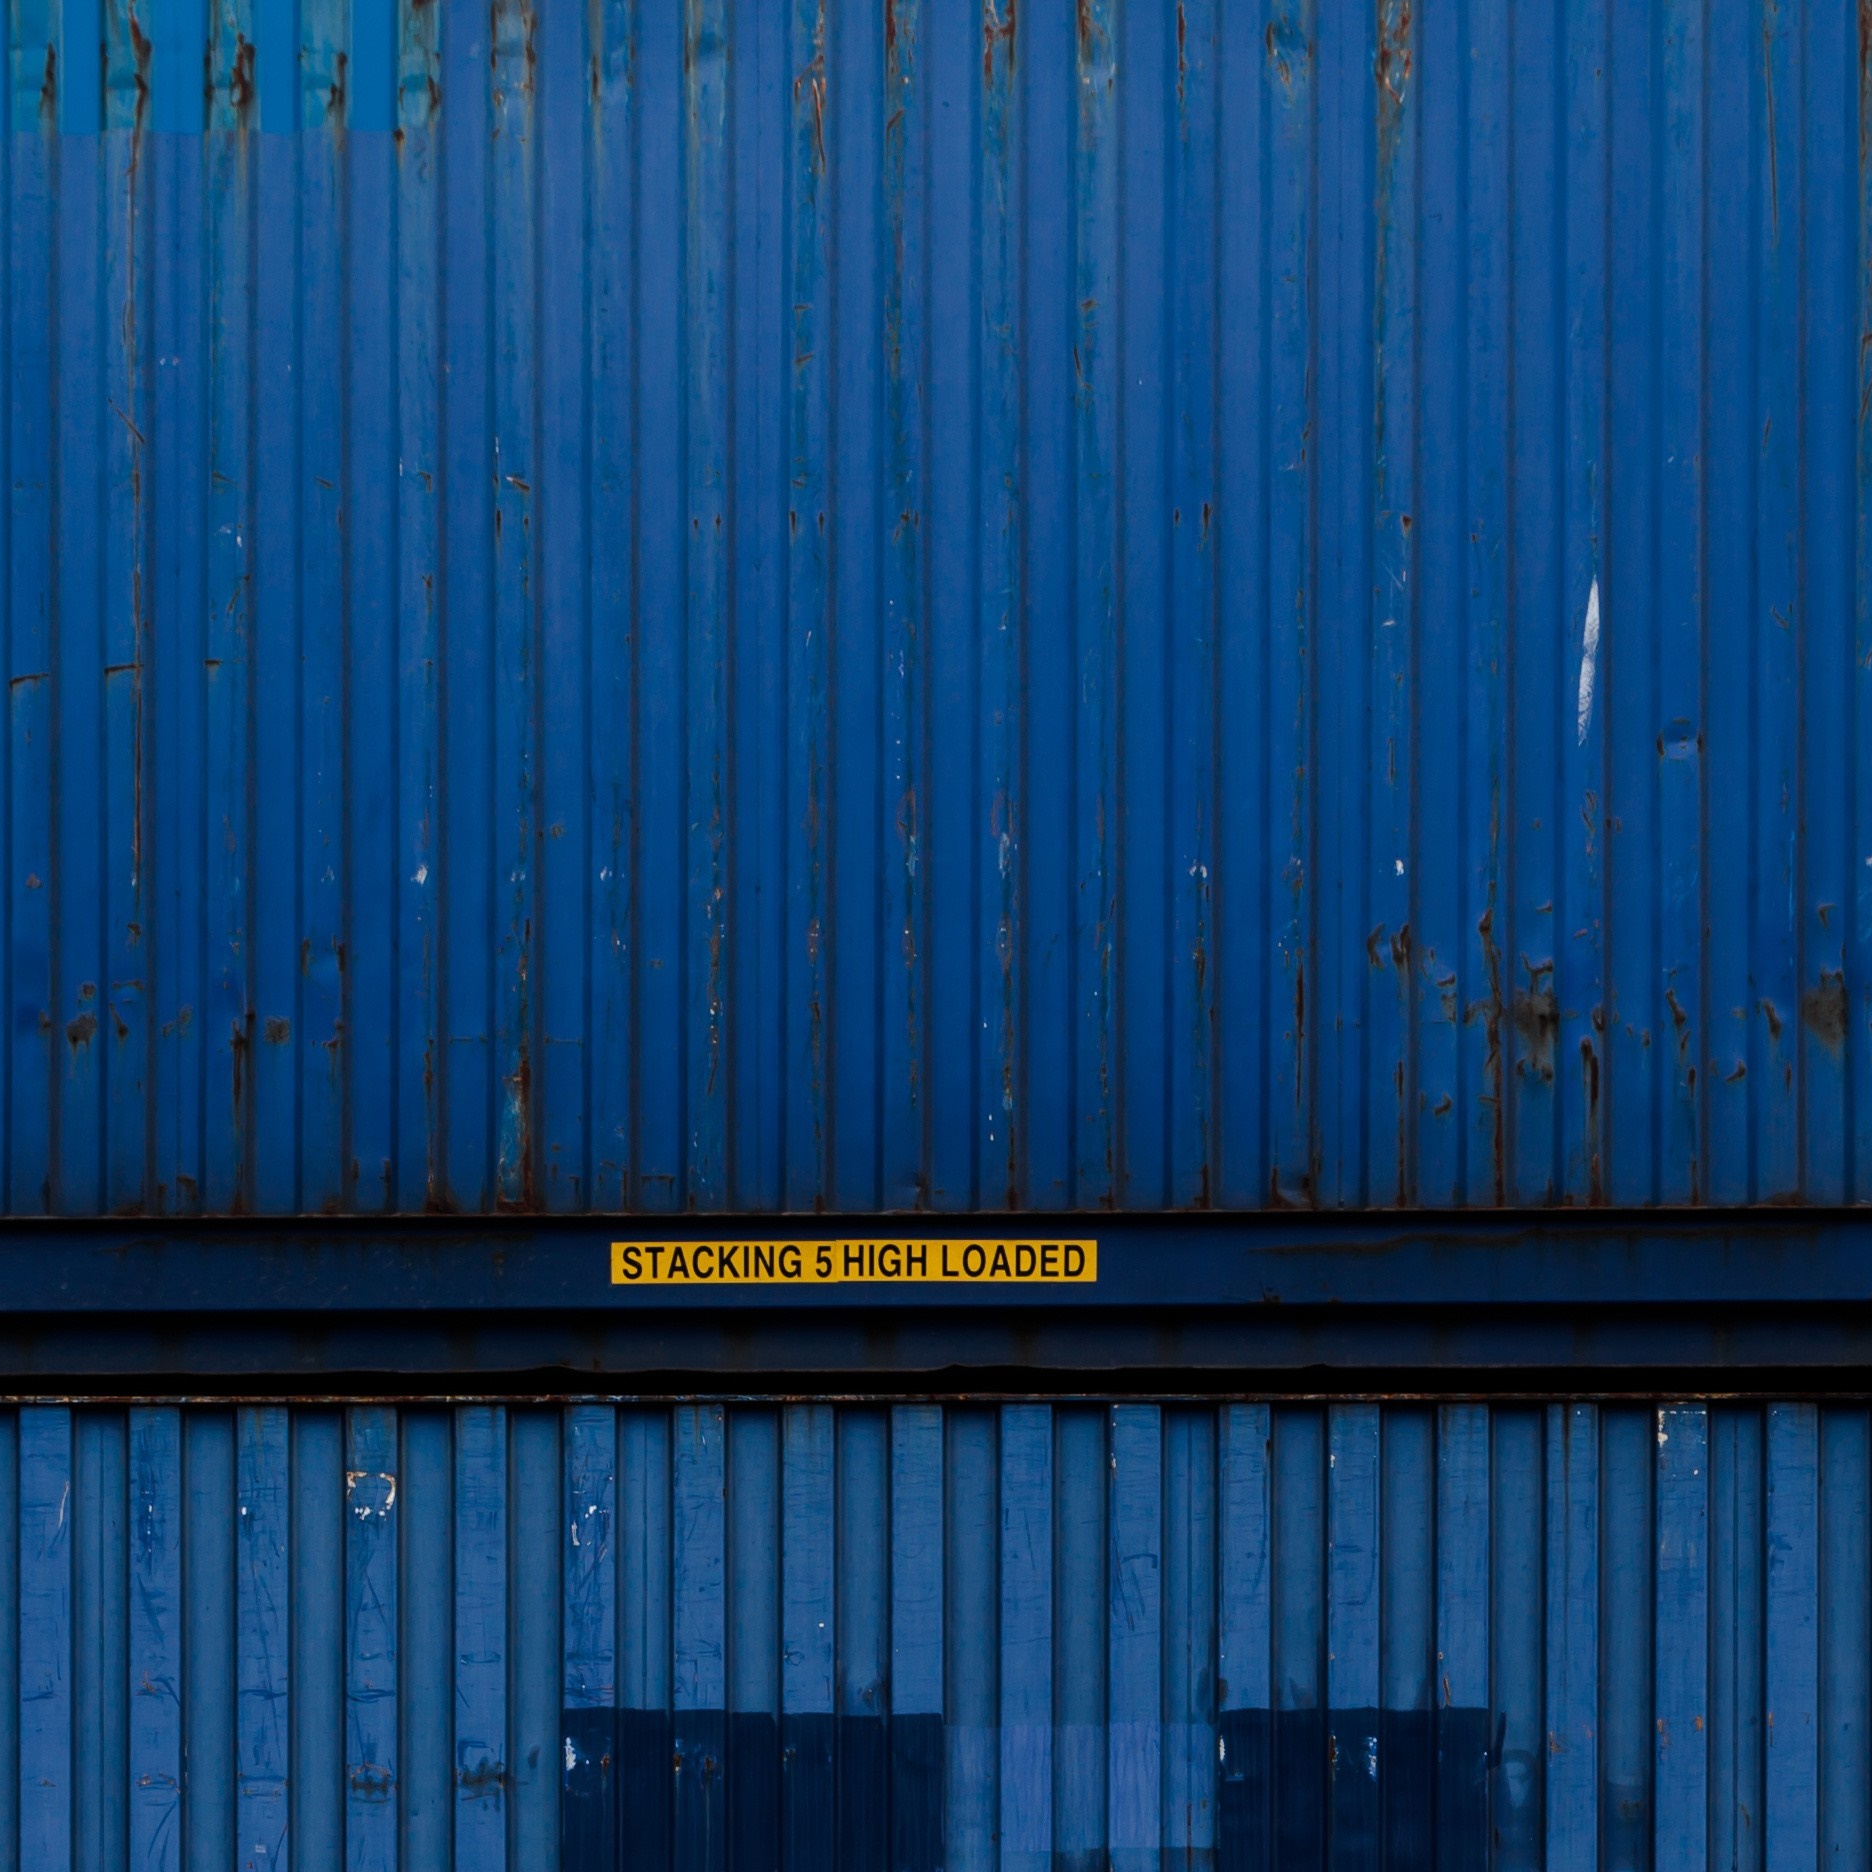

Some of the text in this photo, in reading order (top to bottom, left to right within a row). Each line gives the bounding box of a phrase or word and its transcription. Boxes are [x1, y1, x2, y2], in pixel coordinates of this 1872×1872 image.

[622, 1243, 1086, 1280] STACKING 5 HIGH LOADED
